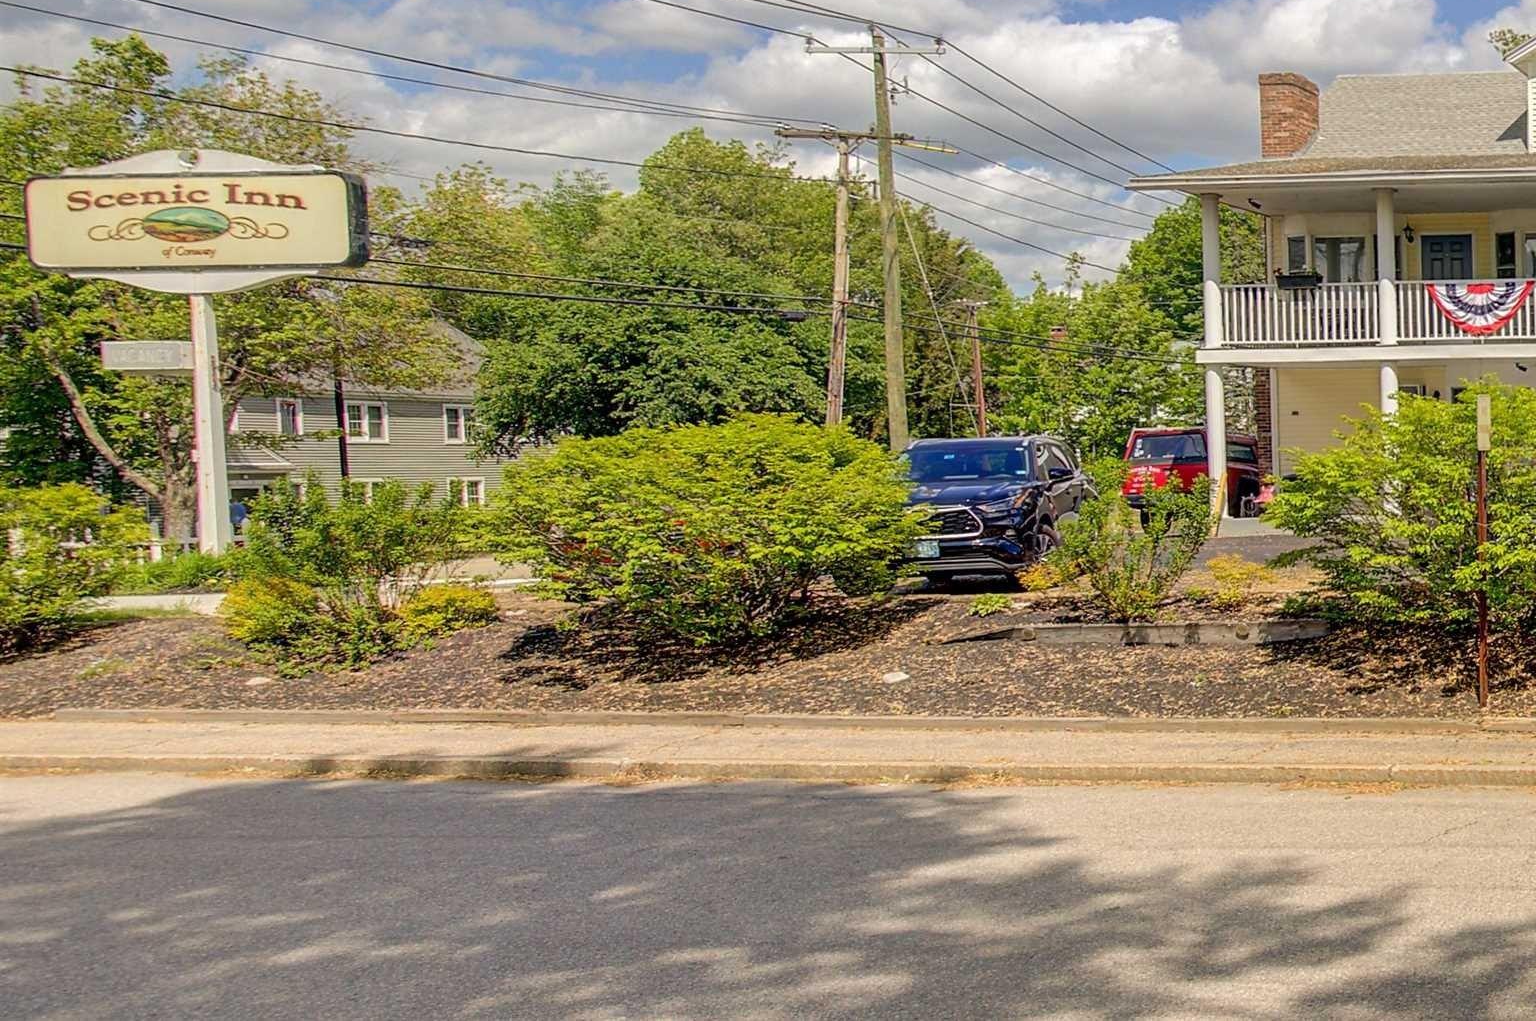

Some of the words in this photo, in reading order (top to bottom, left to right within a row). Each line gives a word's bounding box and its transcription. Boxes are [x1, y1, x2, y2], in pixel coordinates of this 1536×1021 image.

[67, 184, 209, 211] Scenic
[222, 183, 308, 210] Inn
[161, 245, 175, 259] of
